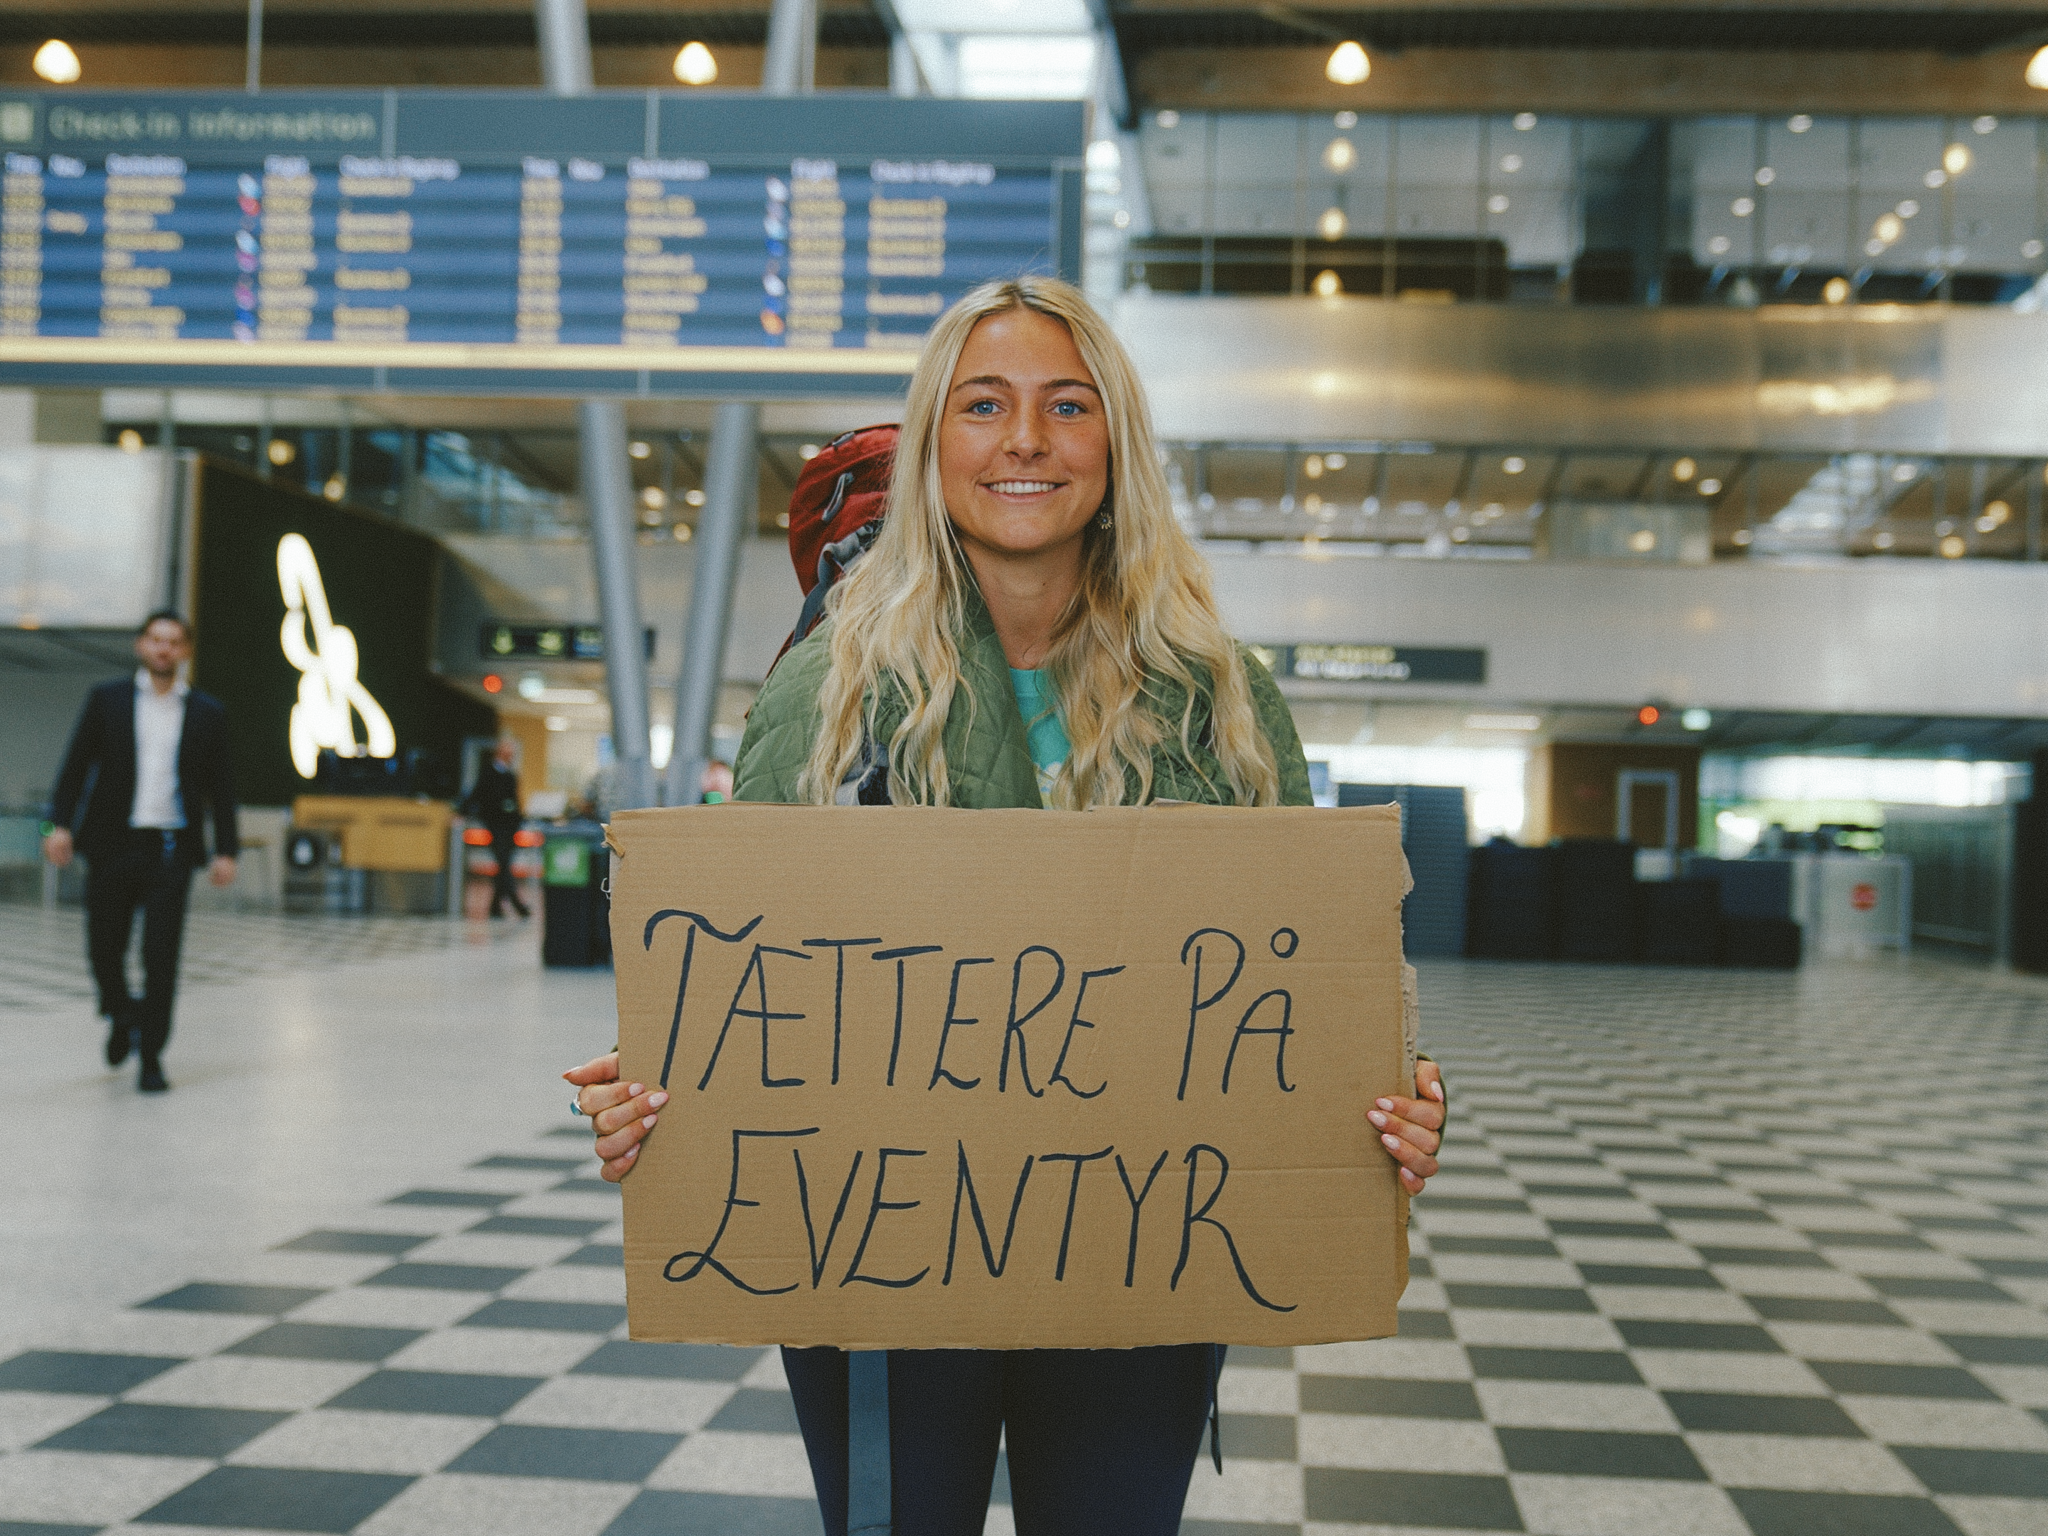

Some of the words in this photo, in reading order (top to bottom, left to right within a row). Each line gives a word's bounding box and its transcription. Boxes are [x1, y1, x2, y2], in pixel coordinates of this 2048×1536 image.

[644, 910, 1126, 1099] TÆTTERE
[1177, 928, 1299, 1101] PÅ
[663, 1127, 1298, 1312] EVENTYR
